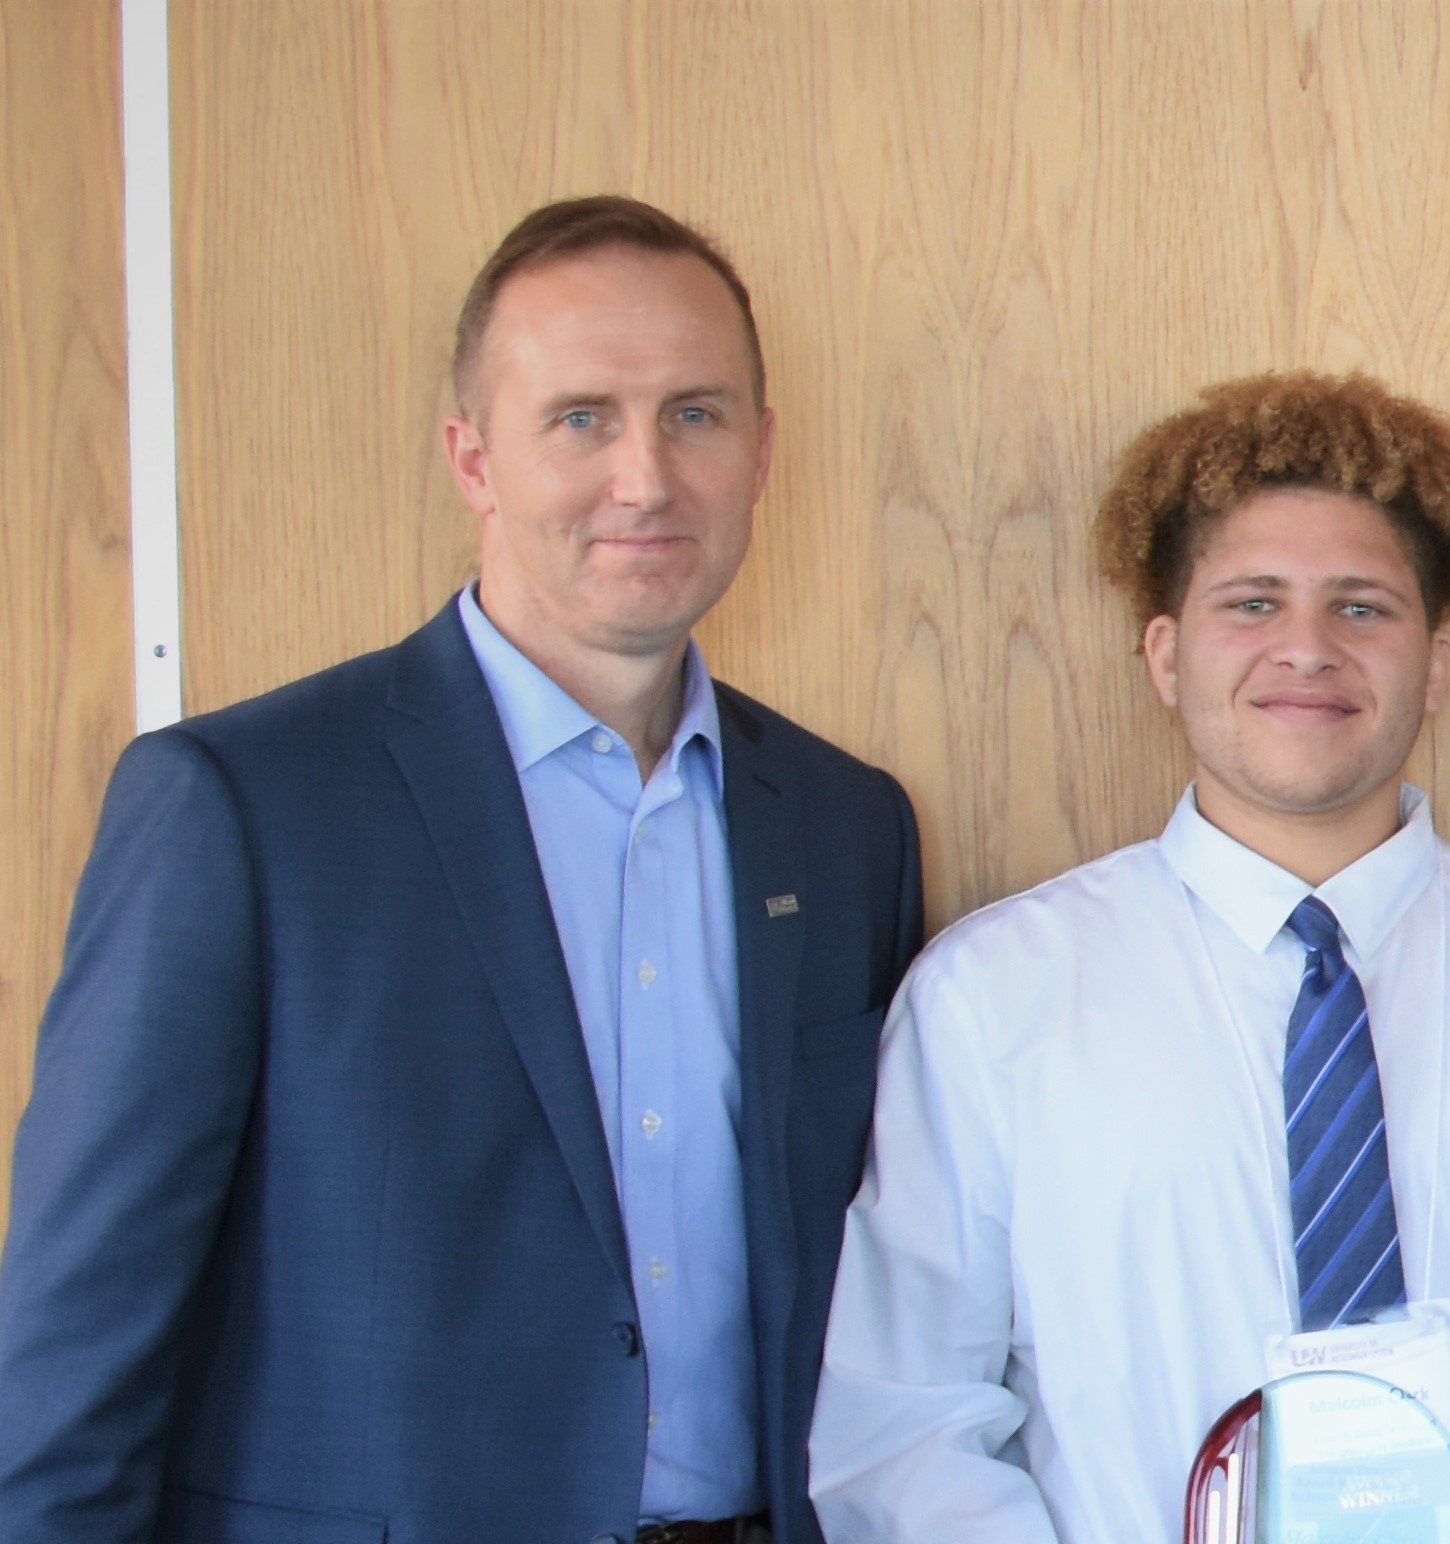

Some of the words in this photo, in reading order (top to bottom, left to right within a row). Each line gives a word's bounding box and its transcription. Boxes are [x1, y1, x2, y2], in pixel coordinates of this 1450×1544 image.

[1291, 1346, 1327, 1368] UW
[1309, 1394, 1382, 1415] Malcolm
[1338, 1486, 1418, 1509] WINNER
